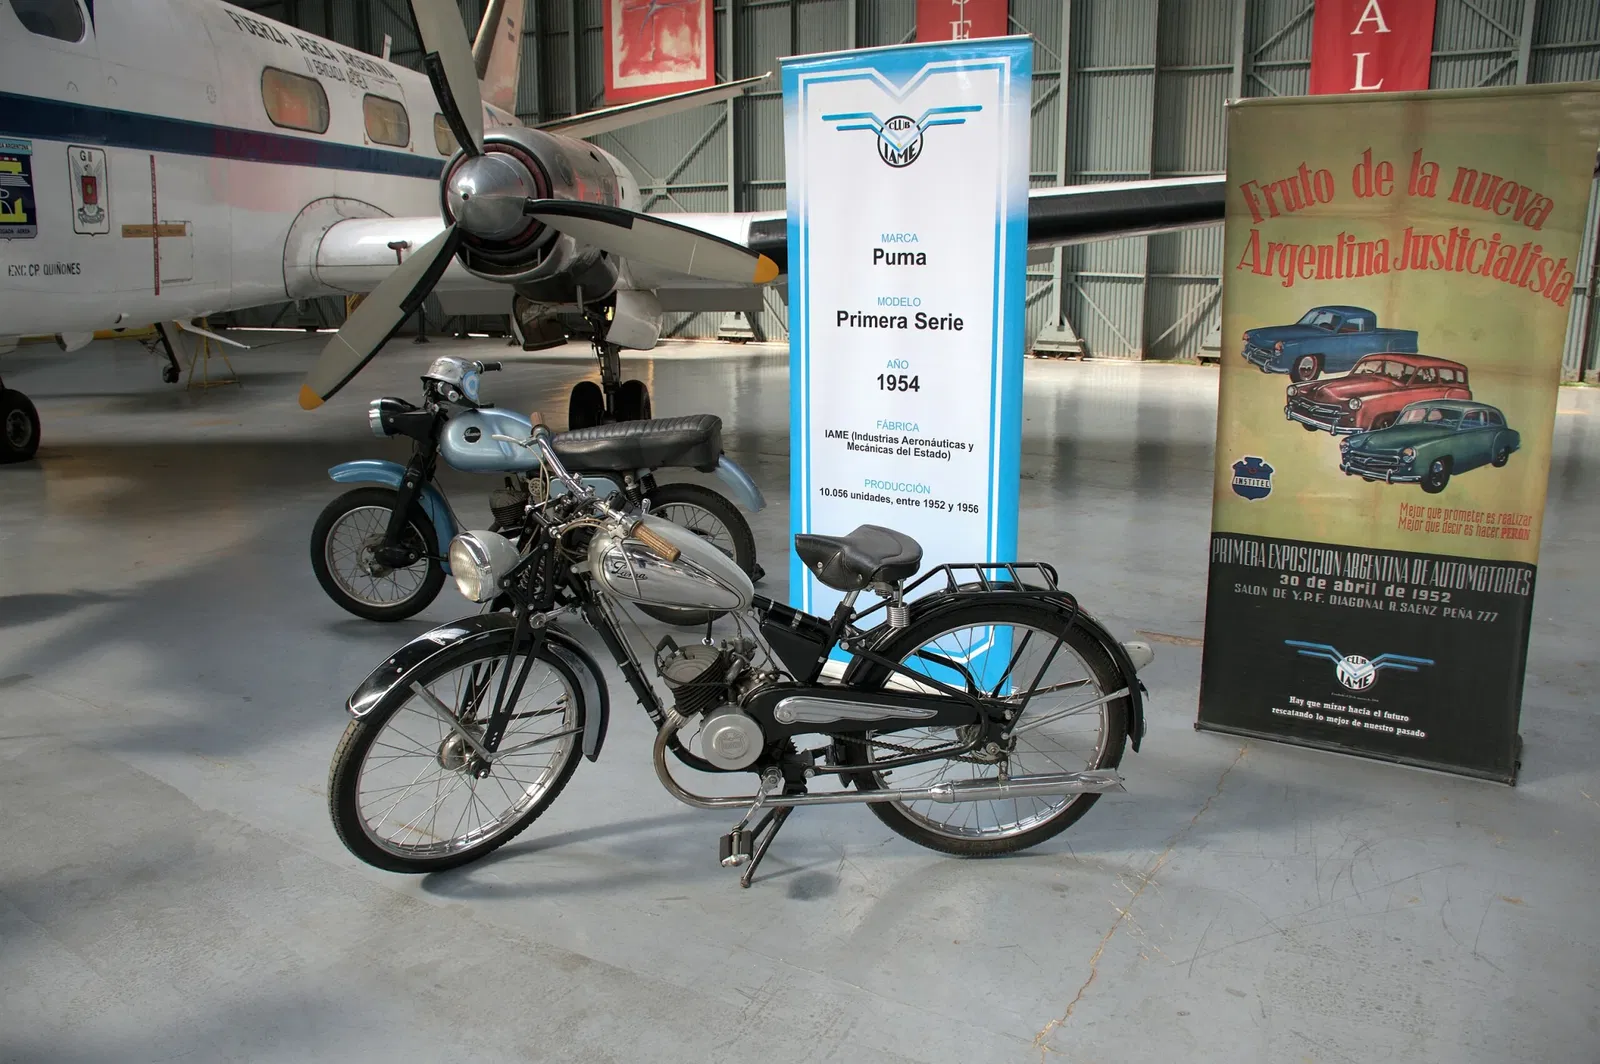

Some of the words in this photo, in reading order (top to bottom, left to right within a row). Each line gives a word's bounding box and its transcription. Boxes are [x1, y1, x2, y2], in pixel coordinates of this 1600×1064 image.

[224, 9, 292, 47] FUERZA
[291, 32, 339, 63] AEREA
[336, 49, 397, 81] ARGENTINA
[313, 59, 346, 83] BRIGADA
[889, 119, 910, 131] CLUB
[885, 138, 918, 164] IAME
[1239, 161, 1335, 225] Fruto
[1352, 147, 1394, 198] de
[1407, 147, 1440, 198] la
[1447, 166, 1554, 231] nueva
[881, 233, 919, 243] MARCA
[873, 248, 927, 266] Puma
[1236, 228, 1391, 288] Argentina
[1393, 226, 1575, 307] Justicialista
[43, 262, 81, 276] QUIÑONES
[877, 297, 922, 307] MODELO
[836, 310, 908, 329] Primera
[914, 311, 964, 331] Serie
[886, 358, 909, 370] AÑO
[877, 373, 921, 392] 1954
[876, 420, 920, 432] FÁBRICA
[824, 429, 849, 440] IAME
[851, 431, 899, 444] (Industrias
[901, 436, 966, 450] Aeronáuticas
[968, 442, 974, 452] y
[846, 441, 894, 455] Mecánicas
[896, 447, 911, 456] del
[914, 449, 951, 461] Estado)
[864, 479, 931, 494] PRODUCCIÓN
[819, 487, 849, 498] 10.056
[850, 491, 894, 505] unidades,
[896, 497, 920, 507] entre
[923, 499, 946, 510] 1952
[948, 503, 955, 512] y
[956, 503, 979, 513] 1956
[1400, 502, 1425, 517] Mejor
[1427, 507, 1442, 520] que
[1444, 509, 1484, 524] prometer
[1486, 512, 1496, 525] es
[1498, 513, 1533, 527] realizar
[1398, 516, 1423, 531] Mejor
[1425, 519, 1440, 533] que
[1442, 521, 1463, 535] decir
[1464, 524, 1474, 537] es
[1212, 538, 1266, 568] PRIMERA
[1268, 543, 1342, 577] EXPOSICION
[1343, 552, 1409, 583] ARGENTINA
[1411, 558, 1431, 586] DE
[1429, 561, 1532, 596] AUTOMOTORES
[1280, 574, 1300, 587] 30
[1307, 576, 1327, 590] de
[1333, 580, 1376, 596] abril
[1384, 584, 1406, 598] de
[1412, 588, 1452, 603] 1952
[1234, 583, 1268, 596] SALON
[1273, 588, 1287, 599] DE
[1292, 590, 1326, 604] Y.P.F.
[1329, 594, 1384, 611] DIAGONAL
[1442, 606, 1473, 620] PEÑA
[1476, 610, 1499, 622] 777
[1347, 656, 1366, 664] CLUB
[1340, 670, 1373, 688] IAME
[1289, 696, 1304, 707] Hay
[1306, 699, 1321, 709] que
[1323, 702, 1346, 712] mirar
[1348, 704, 1371, 717] hacia
[1373, 710, 1382, 718] el
[1383, 711, 1409, 722] futuro
[1271, 707, 1314, 720] rescatando
[1315, 712, 1324, 721] lo
[1326, 716, 1350, 726] mejor
[1351, 719, 1362, 727] de
[1363, 722, 1394, 733] nuestro
[1396, 726, 1426, 738] pasado
